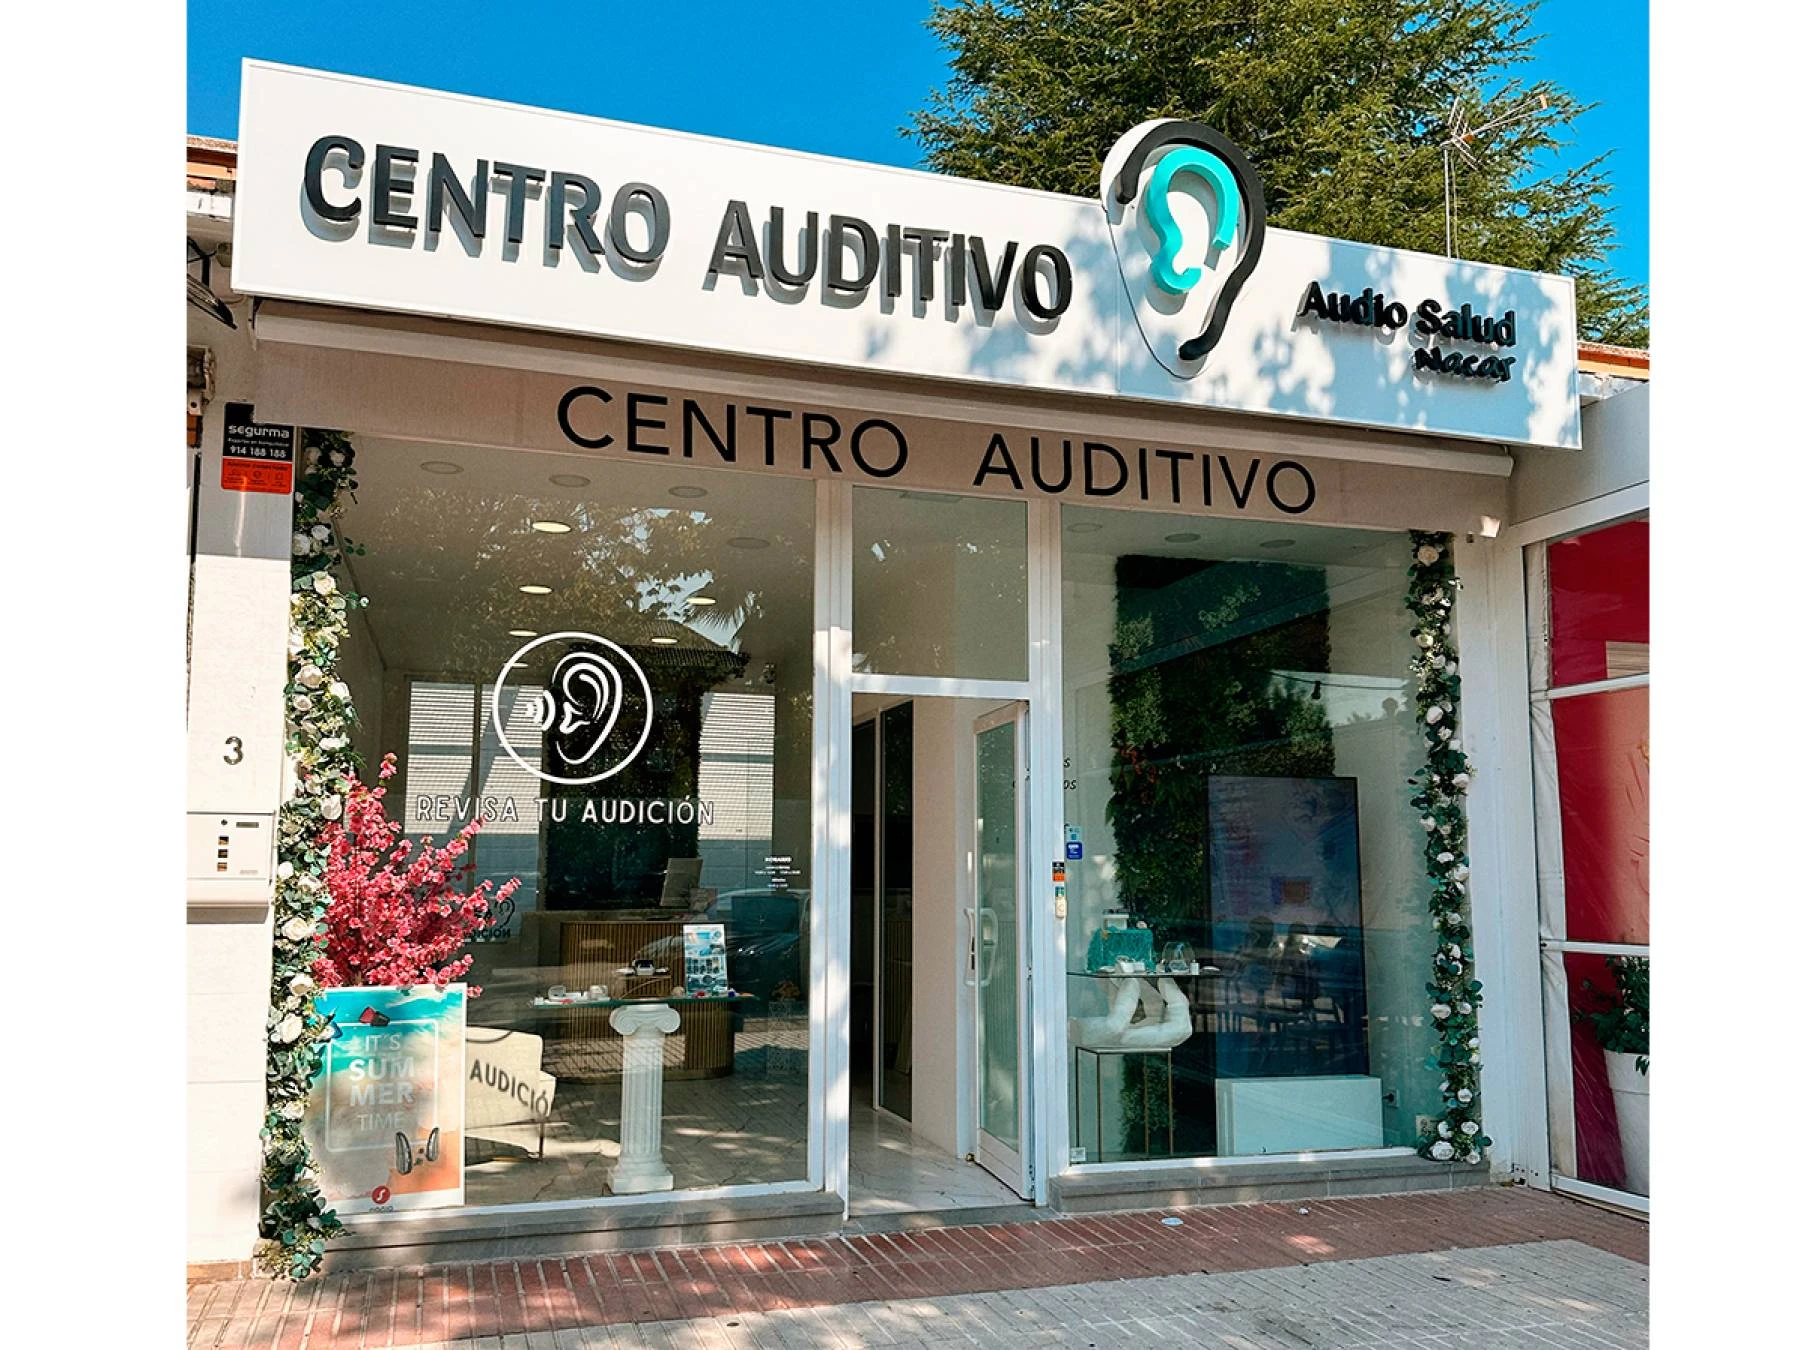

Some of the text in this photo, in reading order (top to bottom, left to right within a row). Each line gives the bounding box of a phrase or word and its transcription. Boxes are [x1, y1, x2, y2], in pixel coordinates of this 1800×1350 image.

[304, 135, 1073, 319] CENTRO AUDITIVO
[1297, 280, 1516, 347] Audio Salud
[1414, 346, 1517, 383] Nacar
[228, 424, 290, 439] segurma
[230, 445, 287, 459] 914 188 188
[557, 386, 1316, 514] CENTRO AUDITIVO
[223, 736, 244, 766] 3
[416, 795, 714, 825] REVISA TU AUDICIÓN
[349, 1056, 415, 1081] SUM
[350, 1081, 415, 1107] MER
[357, 1111, 405, 1132] TIME
